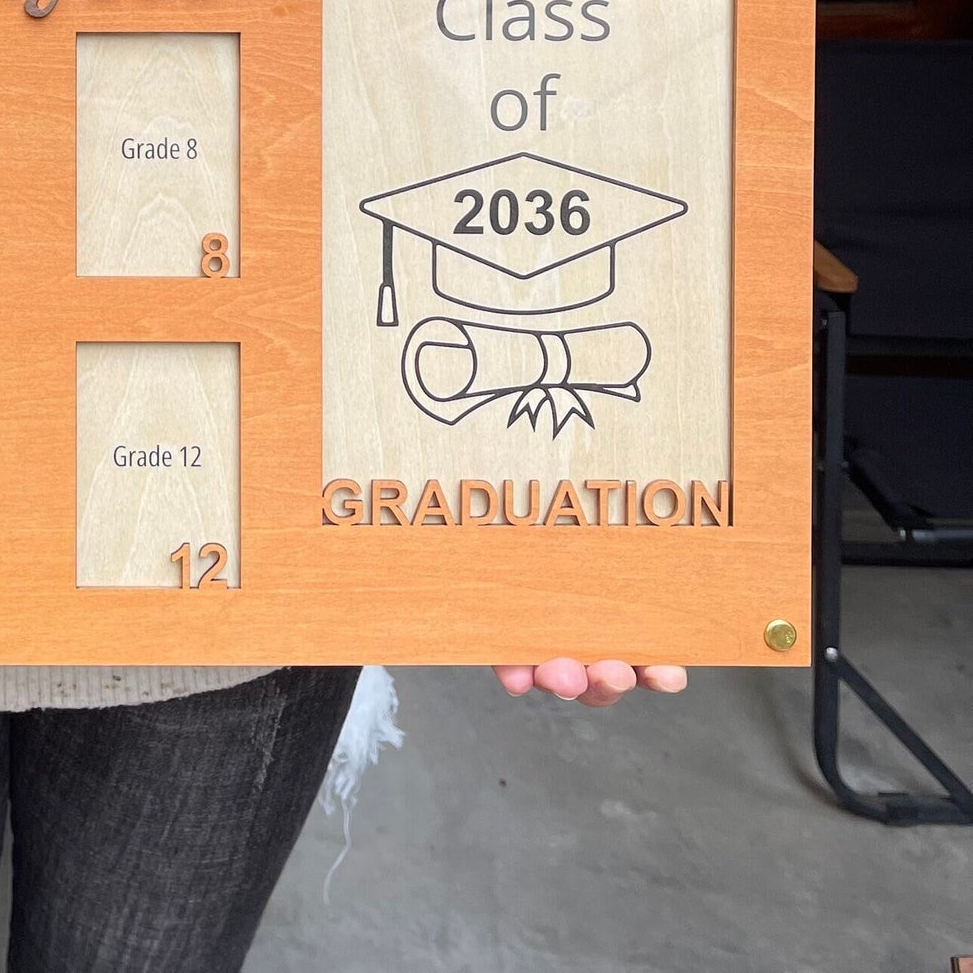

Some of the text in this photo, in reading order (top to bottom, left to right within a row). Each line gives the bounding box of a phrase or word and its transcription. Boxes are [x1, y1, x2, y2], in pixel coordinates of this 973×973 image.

[490, 73, 561, 132] of
[121, 137, 198, 160] Grade 8
[453, 188, 591, 236] 2036
[201, 232, 230, 278] 8
[113, 445, 202, 468] Grade 12
[322, 479, 729, 527] GRADUATION
[170, 543, 228, 588] 12
